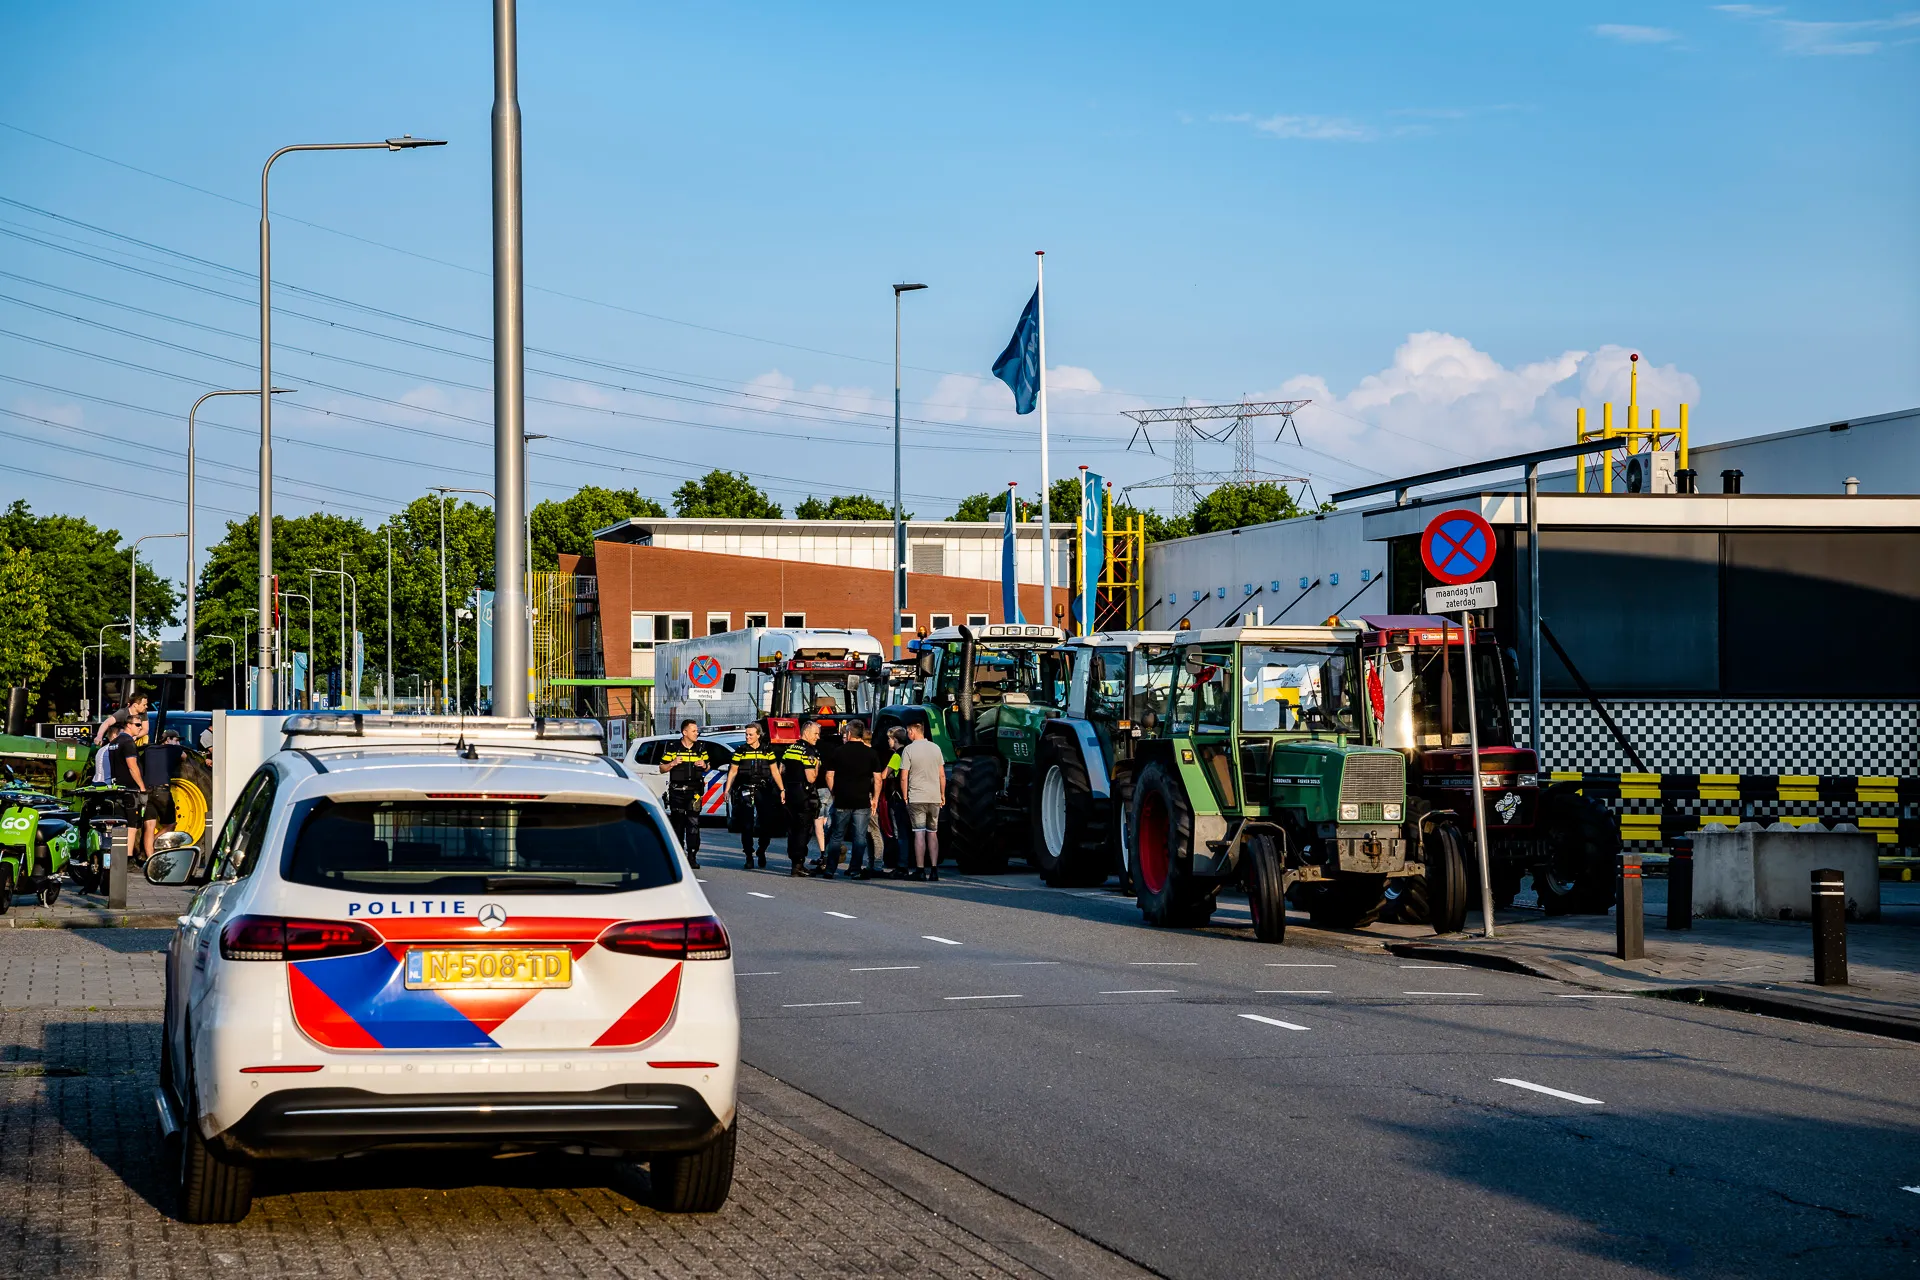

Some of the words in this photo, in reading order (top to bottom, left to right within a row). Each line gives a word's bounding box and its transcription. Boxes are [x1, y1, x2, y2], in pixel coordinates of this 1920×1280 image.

[1436, 587, 1468, 598] maandag
[1470, 585, 1483, 595] t/m
[1446, 598, 1476, 608] zaterdag
[2, 817, 30, 830] GO
[349, 901, 466, 916] POLITIE
[430, 954, 562, 979] N-508-TD
[408, 970, 421, 979] NL
